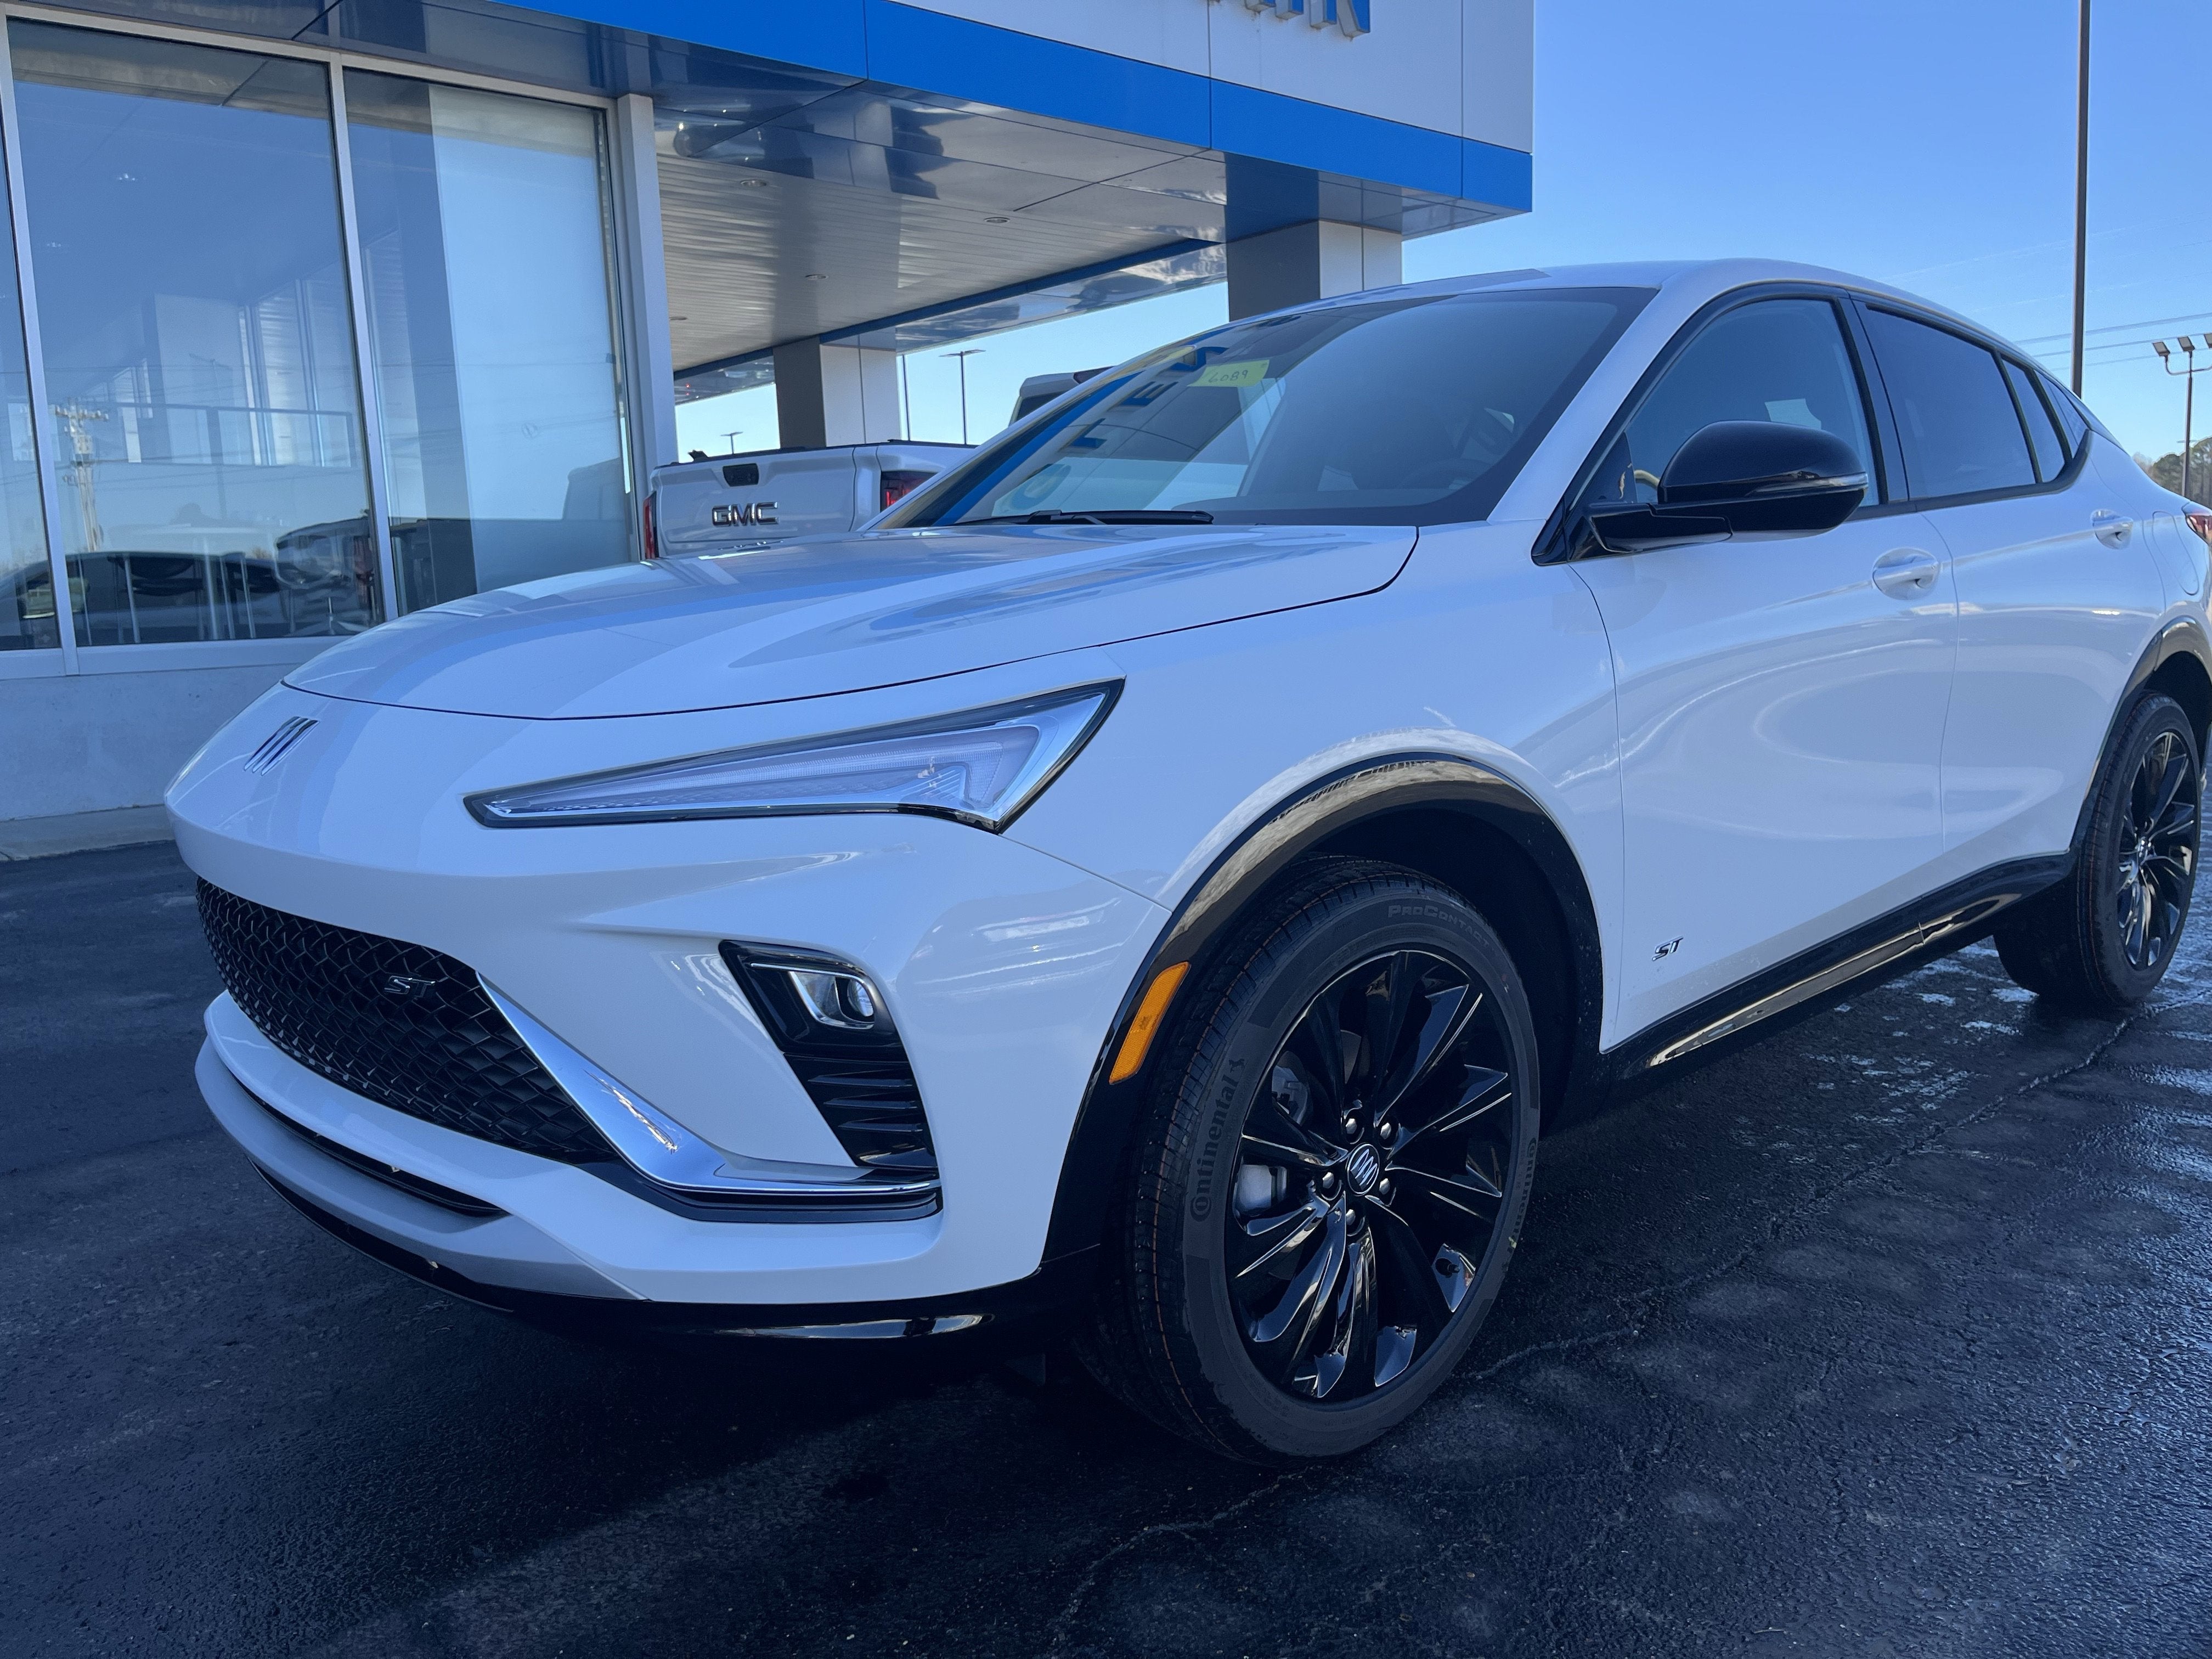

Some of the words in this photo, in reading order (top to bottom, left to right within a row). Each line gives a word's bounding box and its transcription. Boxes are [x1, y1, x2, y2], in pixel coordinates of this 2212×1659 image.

[1209, 370, 1248, 383] 6089
[712, 501, 778, 527] GMC
[1652, 936, 1684, 961] ST
[384, 975, 436, 997] ST
[1190, 1074, 1239, 1222] Continental
